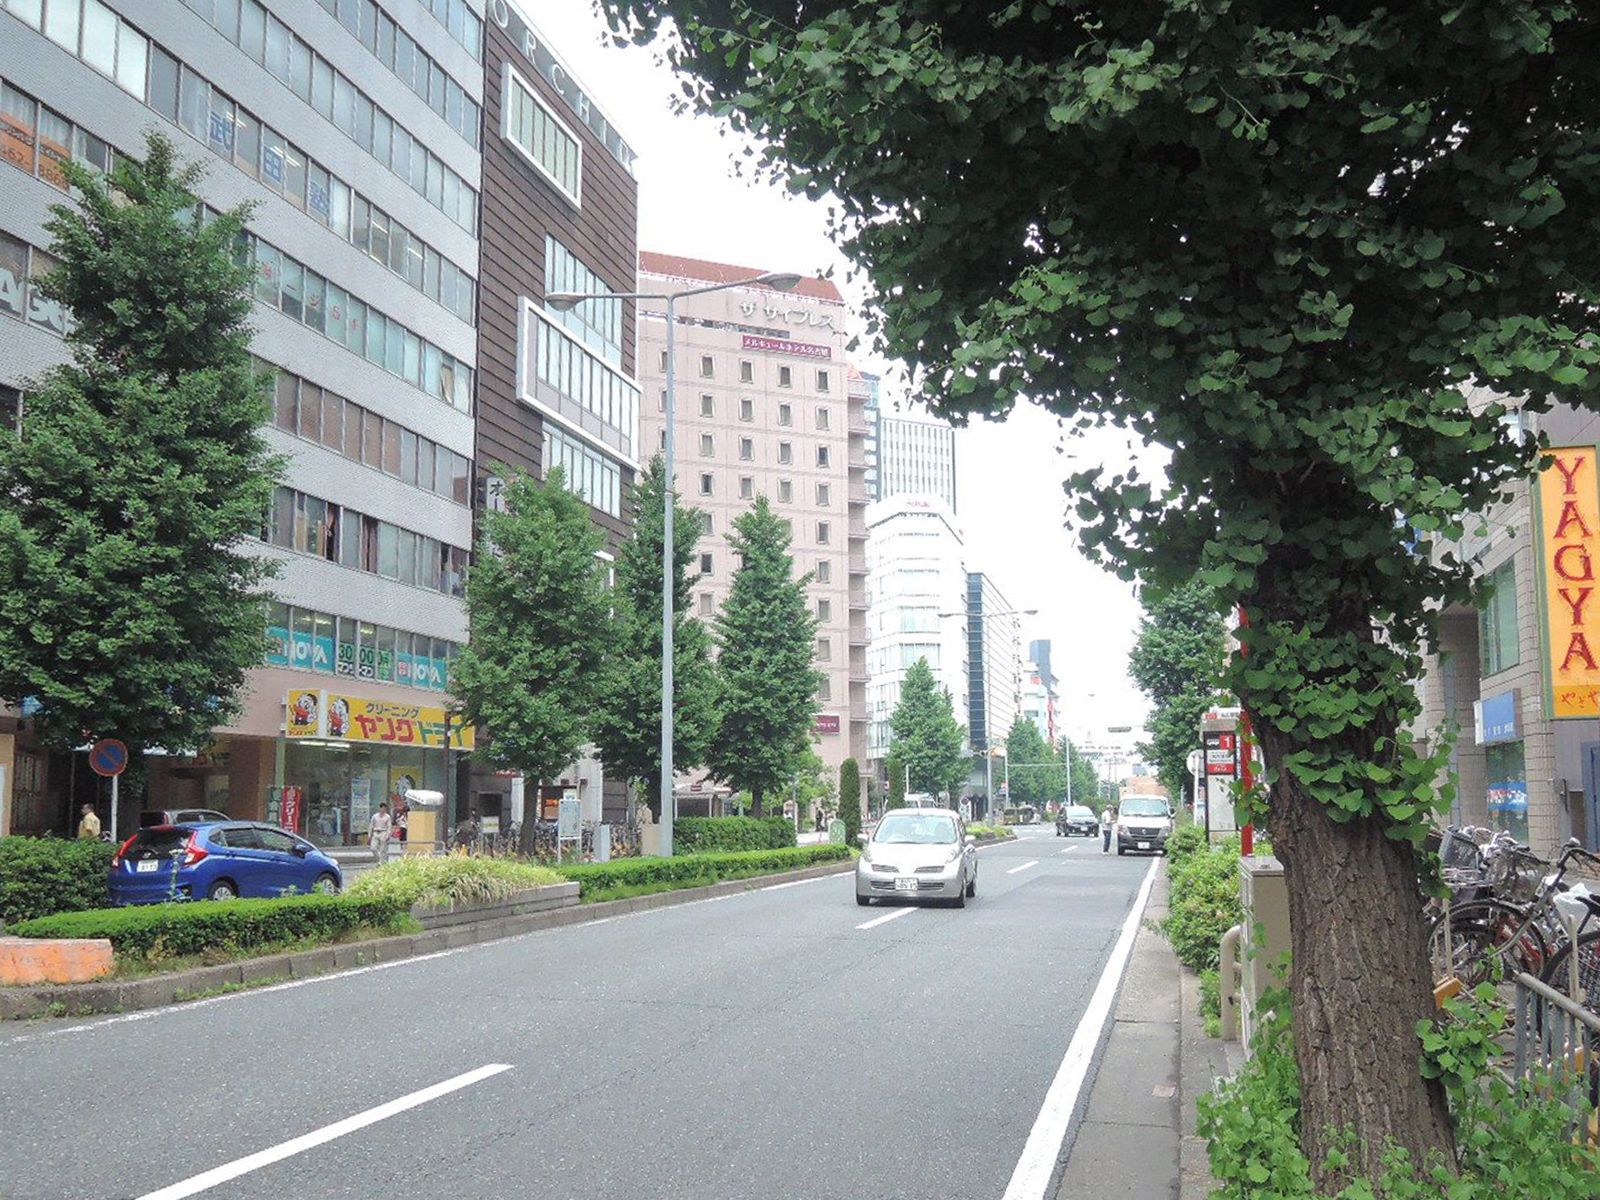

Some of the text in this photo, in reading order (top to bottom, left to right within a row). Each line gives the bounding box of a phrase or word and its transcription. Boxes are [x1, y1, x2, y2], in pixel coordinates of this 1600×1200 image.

[763, 305, 834, 331] サイプレス
[1553, 456, 1600, 672] YAGYA
[366, 702, 419, 719] クリーニング
